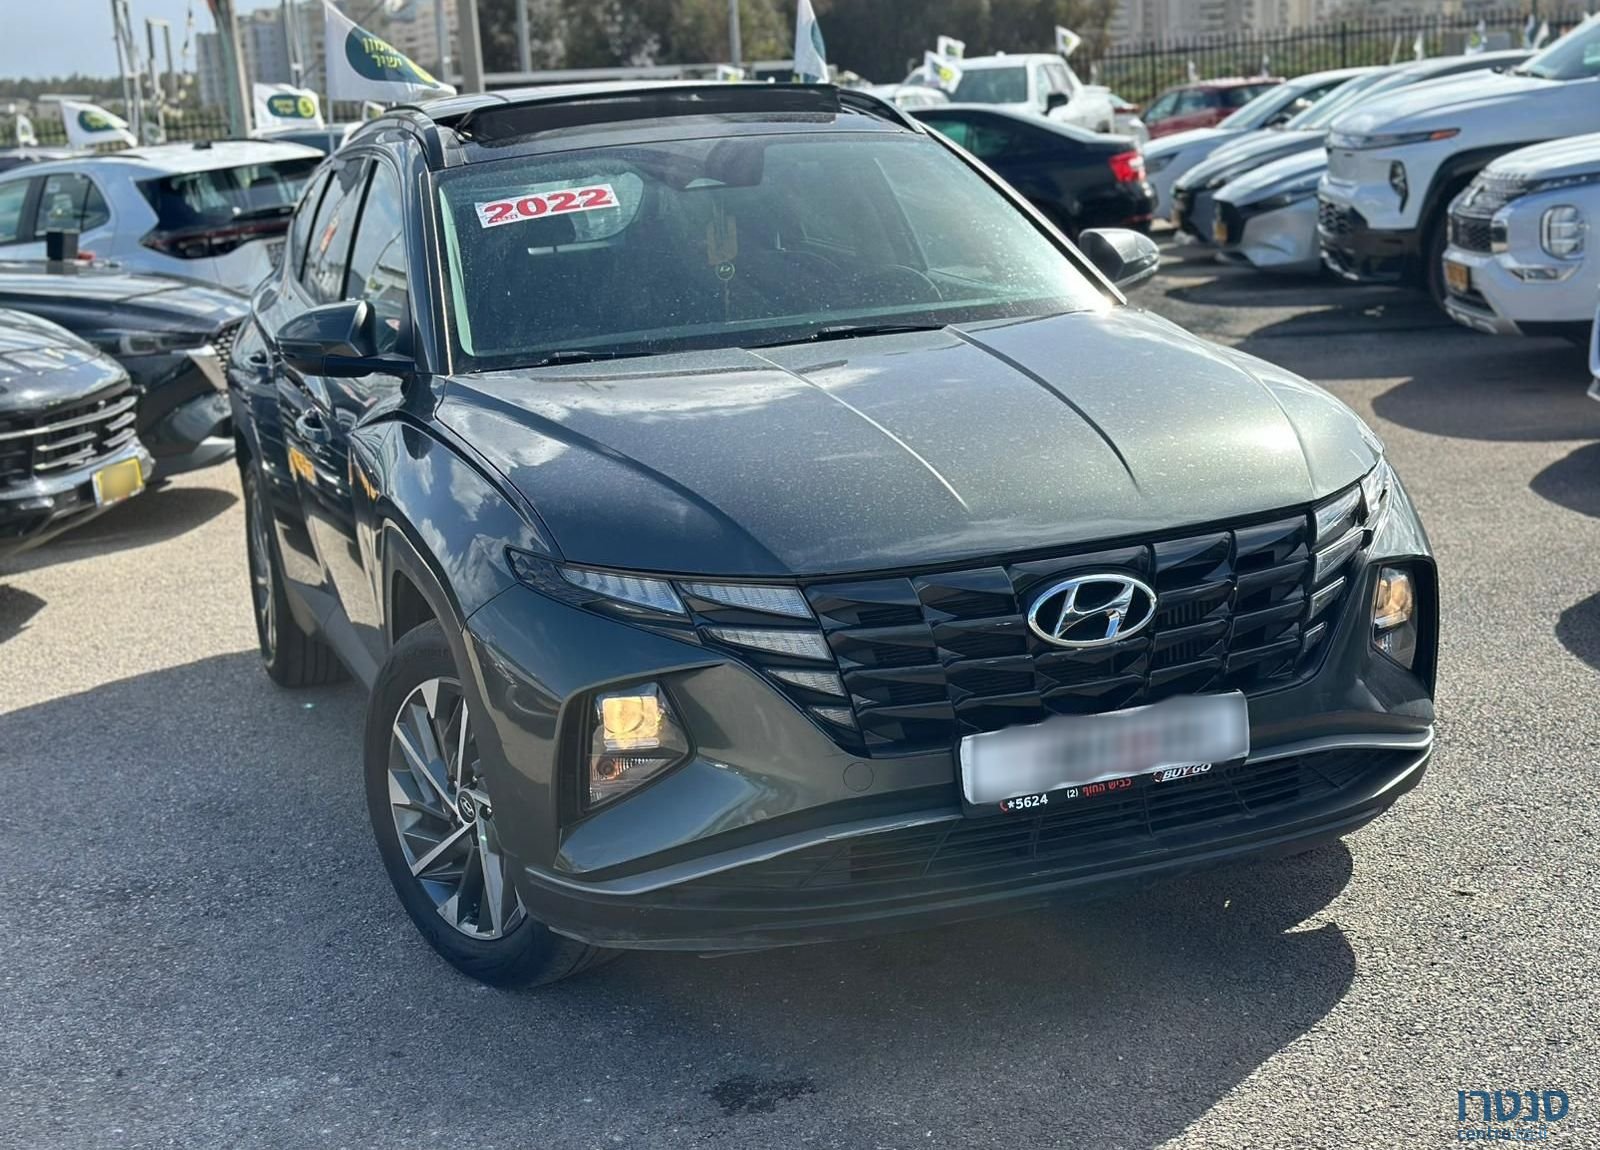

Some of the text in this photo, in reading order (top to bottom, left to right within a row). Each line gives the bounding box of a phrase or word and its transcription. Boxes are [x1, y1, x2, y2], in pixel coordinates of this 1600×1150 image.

[484, 188, 612, 224] 2022
[1163, 766, 1191, 779] BUY
[1066, 778, 1132, 799] כביש החוף (2)
